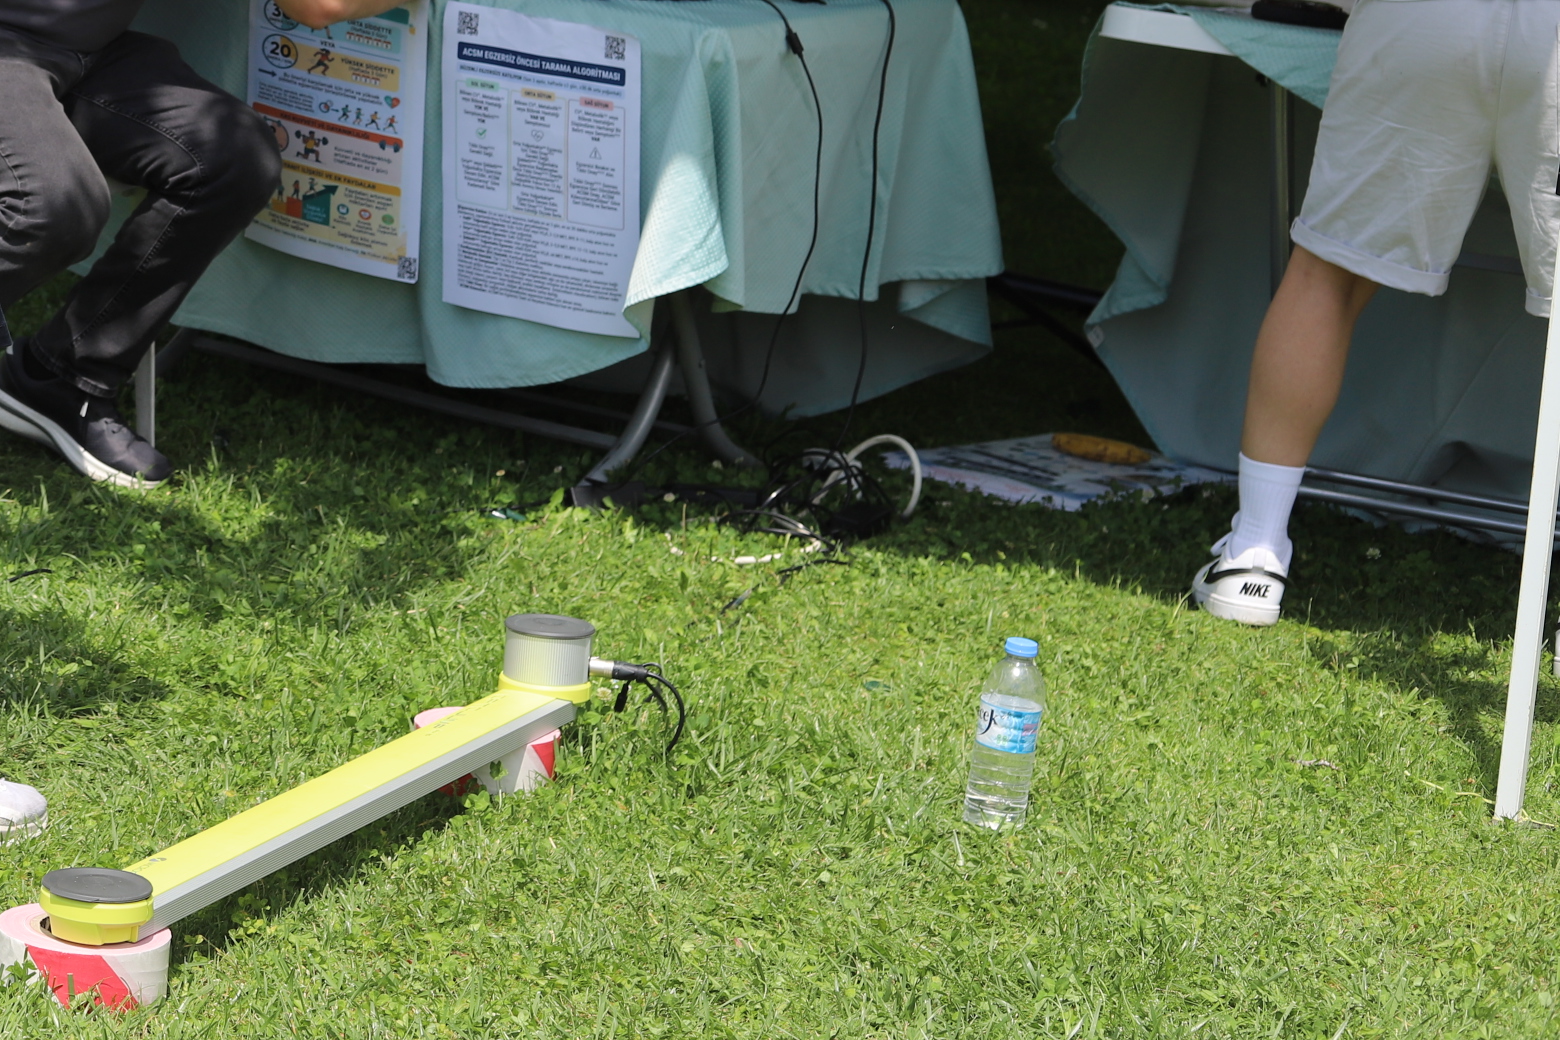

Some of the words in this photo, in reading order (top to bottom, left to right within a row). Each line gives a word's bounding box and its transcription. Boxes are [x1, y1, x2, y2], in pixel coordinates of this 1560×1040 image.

[269, 41, 291, 57] 20
[320, 39, 335, 49] VEYA
[462, 47, 484, 58] ACSM
[484, 50, 516, 64] EGZERSİZ
[516, 55, 540, 69] ÖNCESİ
[541, 61, 572, 74] TARAMA
[572, 65, 621, 82] ALGORİTMASI
[1239, 582, 1271, 599] NIKE
